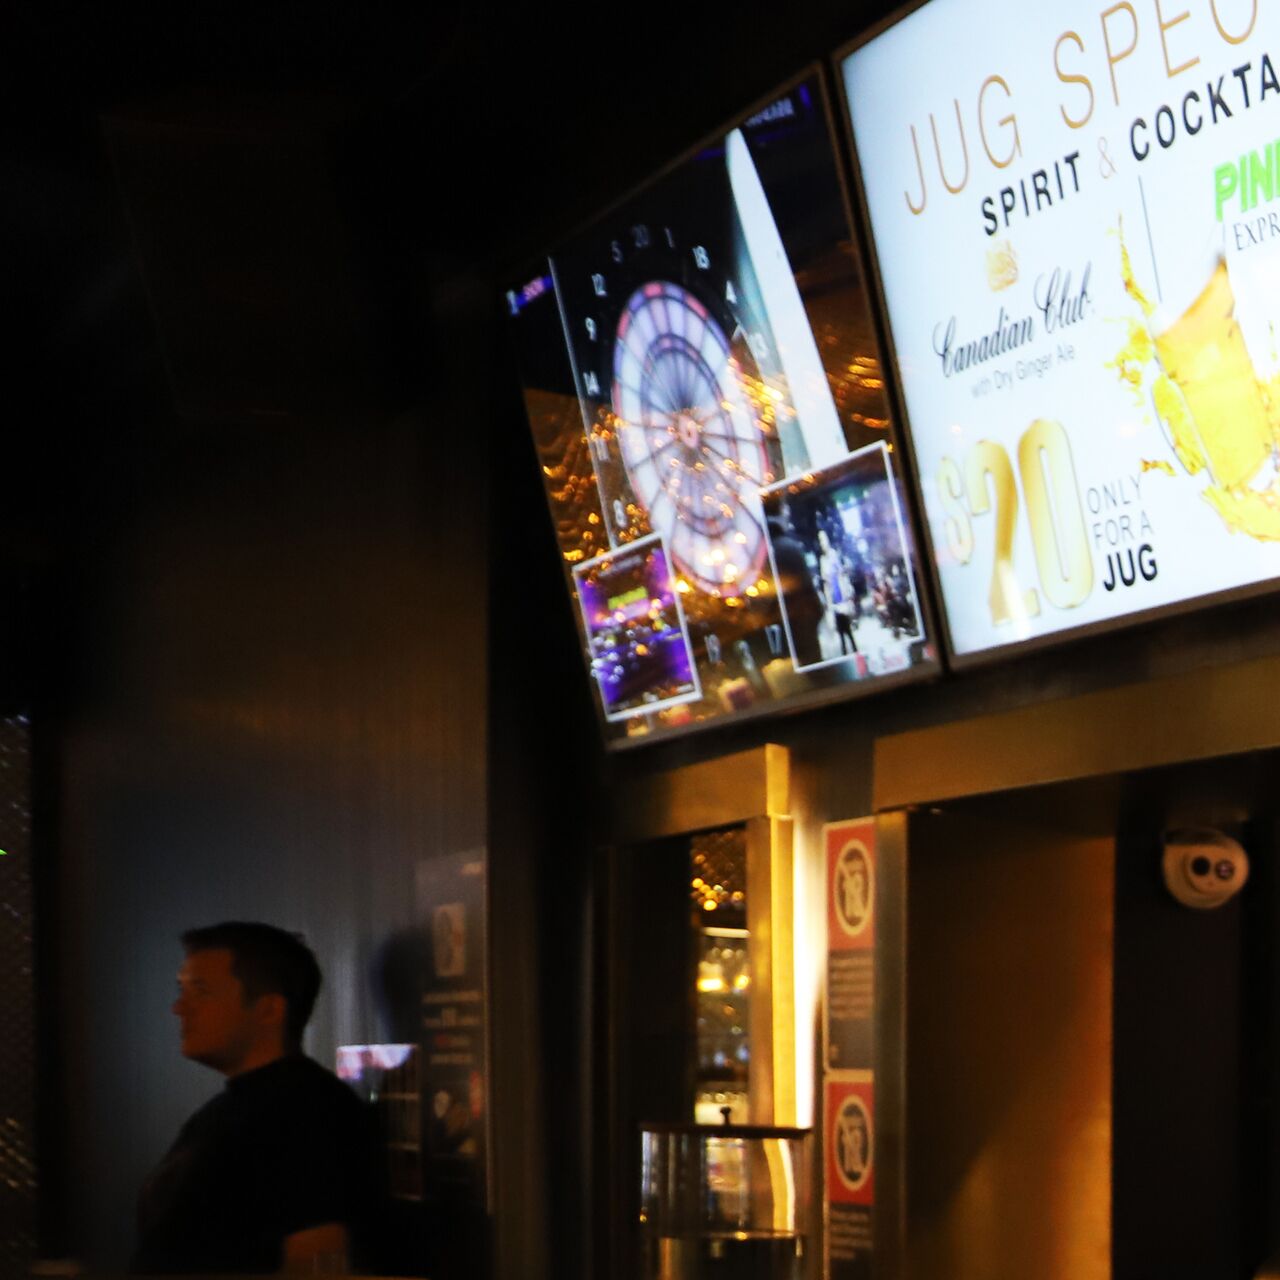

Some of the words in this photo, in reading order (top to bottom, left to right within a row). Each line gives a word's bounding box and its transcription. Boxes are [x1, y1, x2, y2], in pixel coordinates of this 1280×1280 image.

[904, 75, 1022, 216] JUG
[983, 151, 1082, 236] SPIRIT
[933, 307, 1033, 378] Canadian
[937, 419, 1094, 628] $20
[1086, 474, 1143, 514] ONLY
[1092, 516, 1135, 549] FOR
[1140, 510, 1154, 535] A
[1104, 544, 1158, 592] JUG
